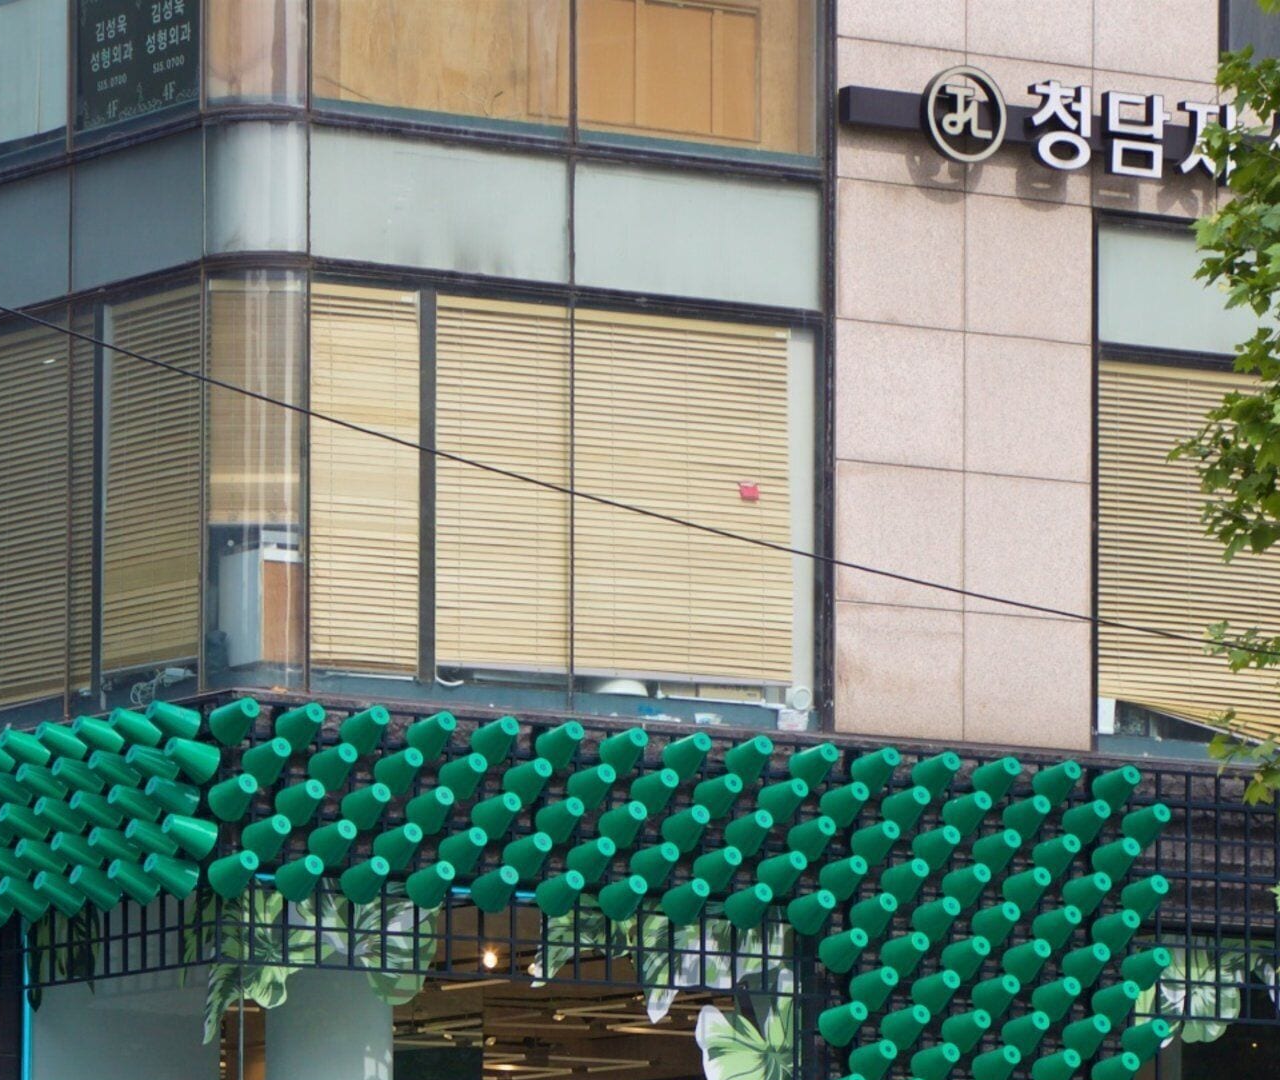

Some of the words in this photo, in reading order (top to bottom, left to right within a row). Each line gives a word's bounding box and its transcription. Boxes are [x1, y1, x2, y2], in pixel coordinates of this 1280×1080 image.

[151, 0, 184, 23] 김성욱
[95, 14, 127, 42] 김성욱
[145, 22, 191, 54] 성형외과
[90, 40, 133, 72] 성형외과
